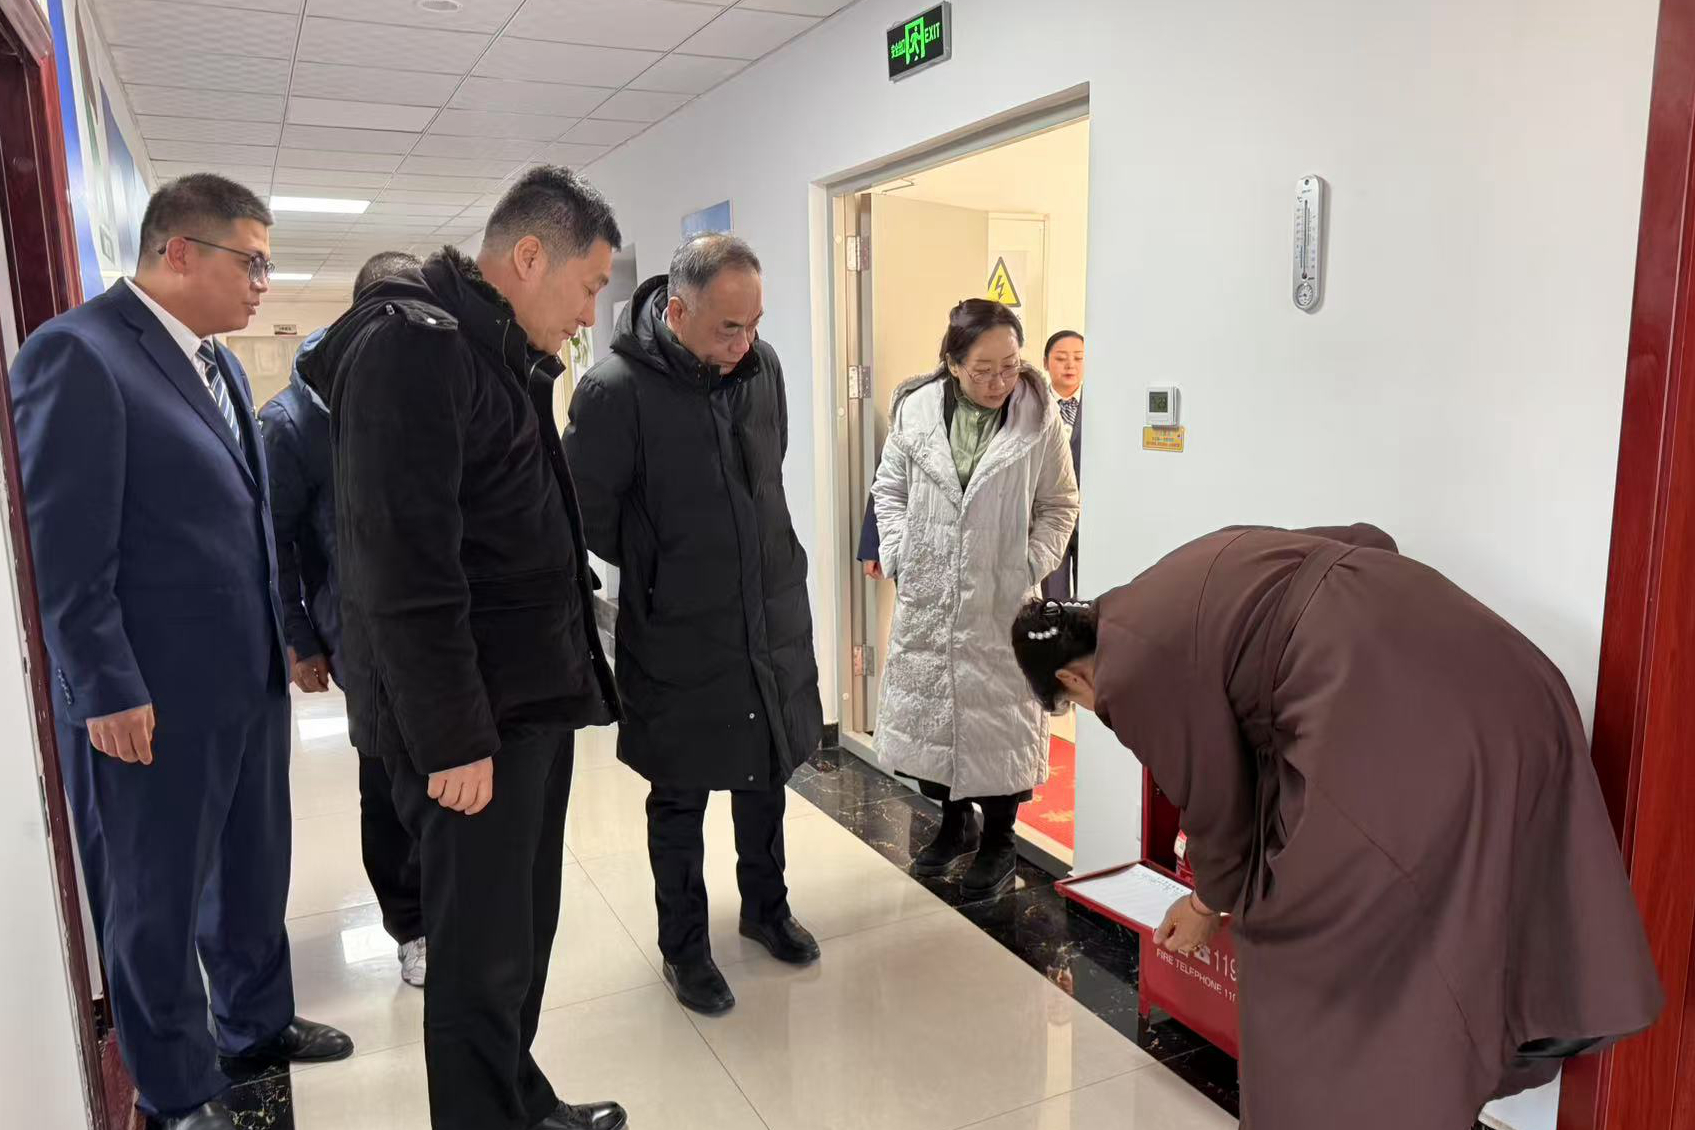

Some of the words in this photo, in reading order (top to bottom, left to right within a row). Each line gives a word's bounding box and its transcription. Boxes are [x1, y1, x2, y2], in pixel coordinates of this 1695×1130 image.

[924, 22, 940, 43] EXIT
[1156, 948, 1175, 966] FIRE
[1175, 959, 1222, 994] TELEPHONE
